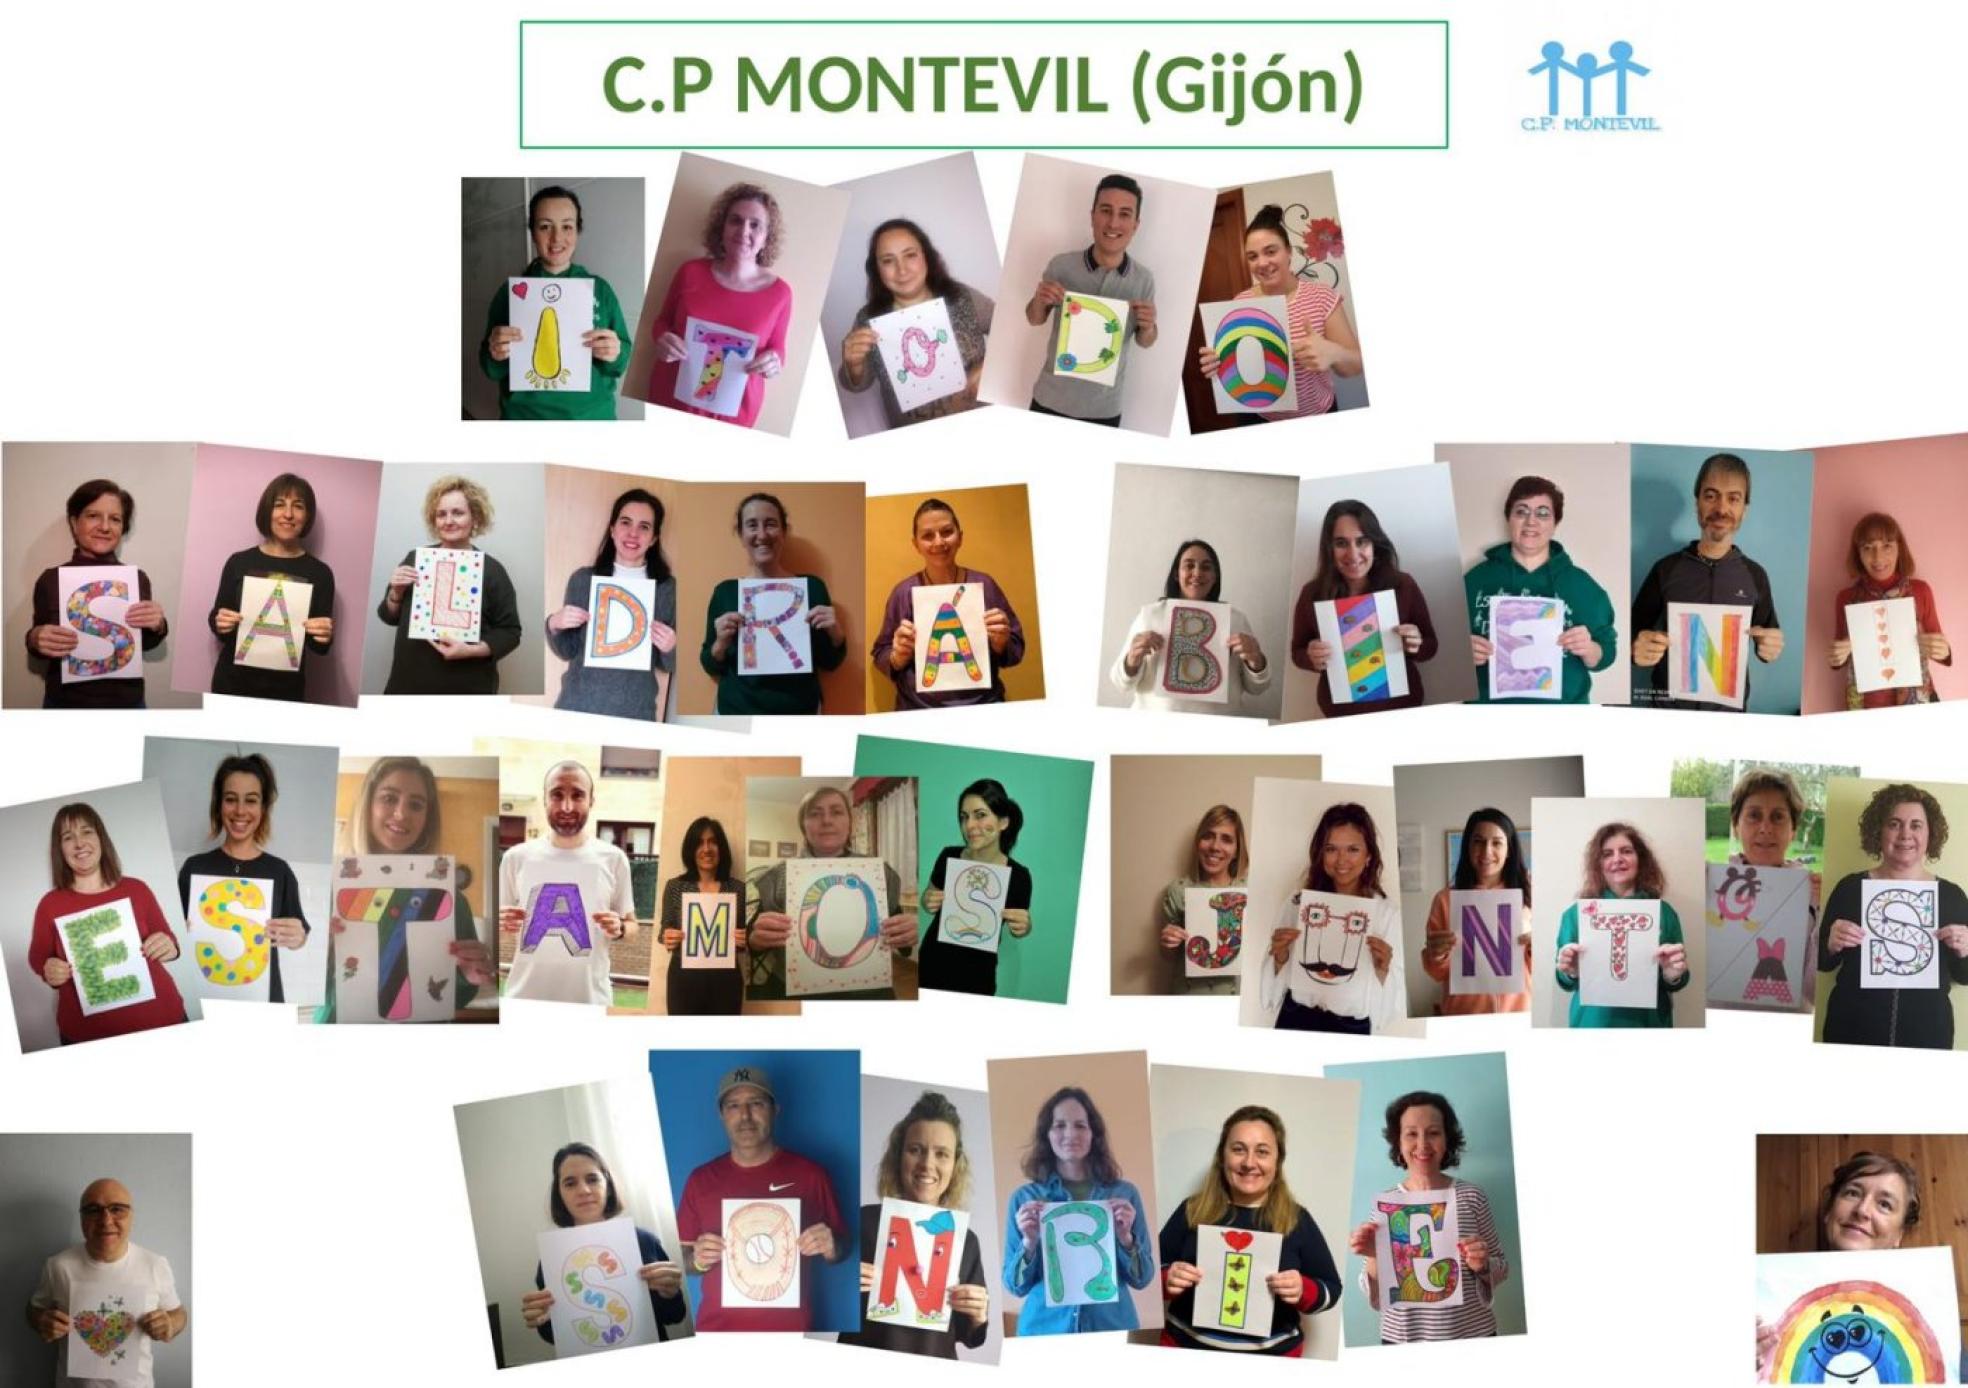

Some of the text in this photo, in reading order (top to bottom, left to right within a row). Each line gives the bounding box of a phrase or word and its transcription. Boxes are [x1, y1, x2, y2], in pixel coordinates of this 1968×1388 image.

[692, 324, 755, 401] T
[1057, 294, 1123, 373] D
[1215, 307, 1290, 408] O
[67, 578, 136, 677] S
[236, 579, 299, 668] A
[431, 561, 472, 629] L
[590, 583, 648, 658] D
[742, 583, 804, 670] R
[922, 585, 983, 688] Á
[1163, 606, 1224, 694] B
[1495, 600, 1556, 693] E
[1679, 612, 1742, 697] N
[195, 879, 270, 986] S
[519, 882, 592, 957] A
[686, 902, 729, 958] M
[799, 872, 880, 969] O
[943, 864, 1001, 942] S
[1186, 891, 1247, 970] J
[1461, 903, 1512, 977] N
[1590, 912, 1653, 981] T
[1866, 888, 1934, 976] S
[64, 908, 140, 1007] E
[336, 888, 454, 1020] T
[562, 1244, 633, 1347] S
[873, 1212, 956, 1320] N
[1041, 1202, 1119, 1303] R
[1377, 1201, 1460, 1304] E
